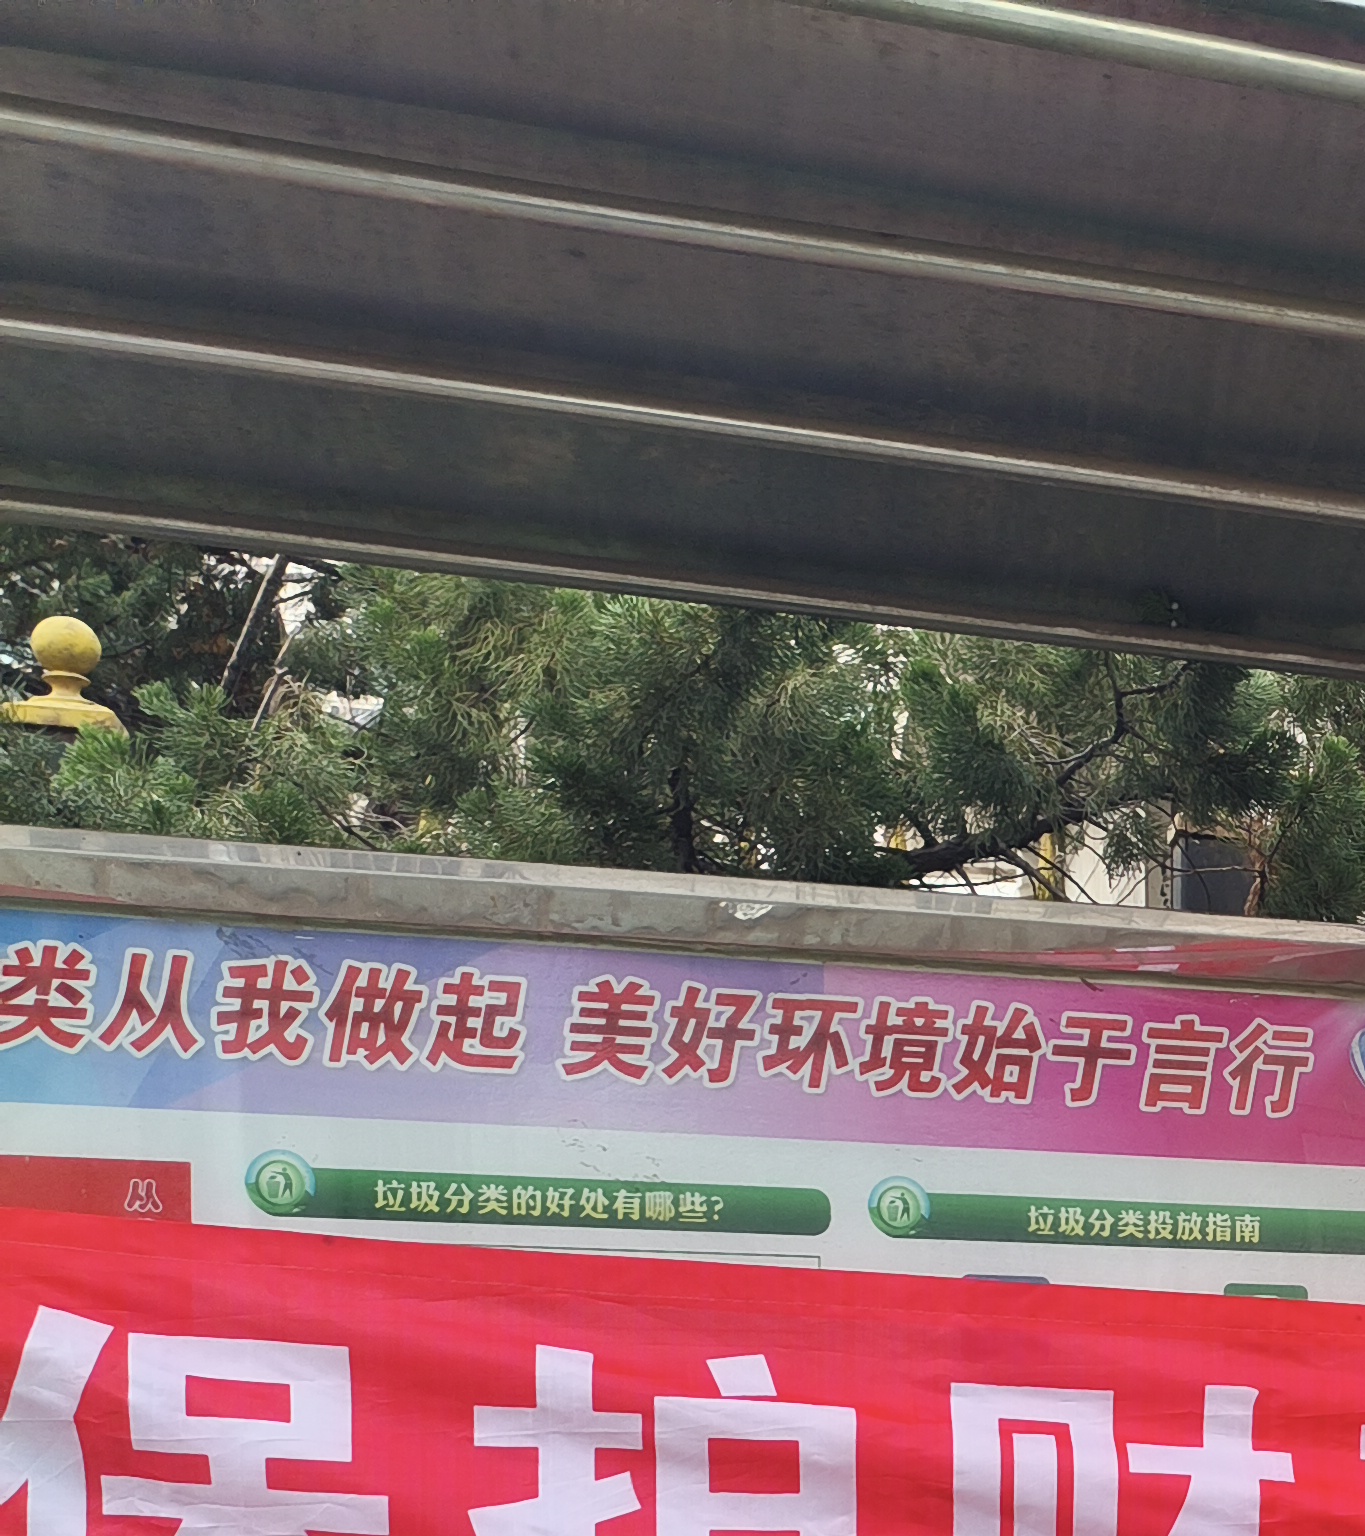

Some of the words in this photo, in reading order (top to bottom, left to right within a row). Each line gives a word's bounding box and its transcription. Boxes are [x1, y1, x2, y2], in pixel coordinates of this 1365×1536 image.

[0, 941, 525, 1072] 类从我做起
[561, 978, 1315, 1117] 美好环境始于言行
[1027, 1204, 1261, 1244] 垃圾分类投放指南
